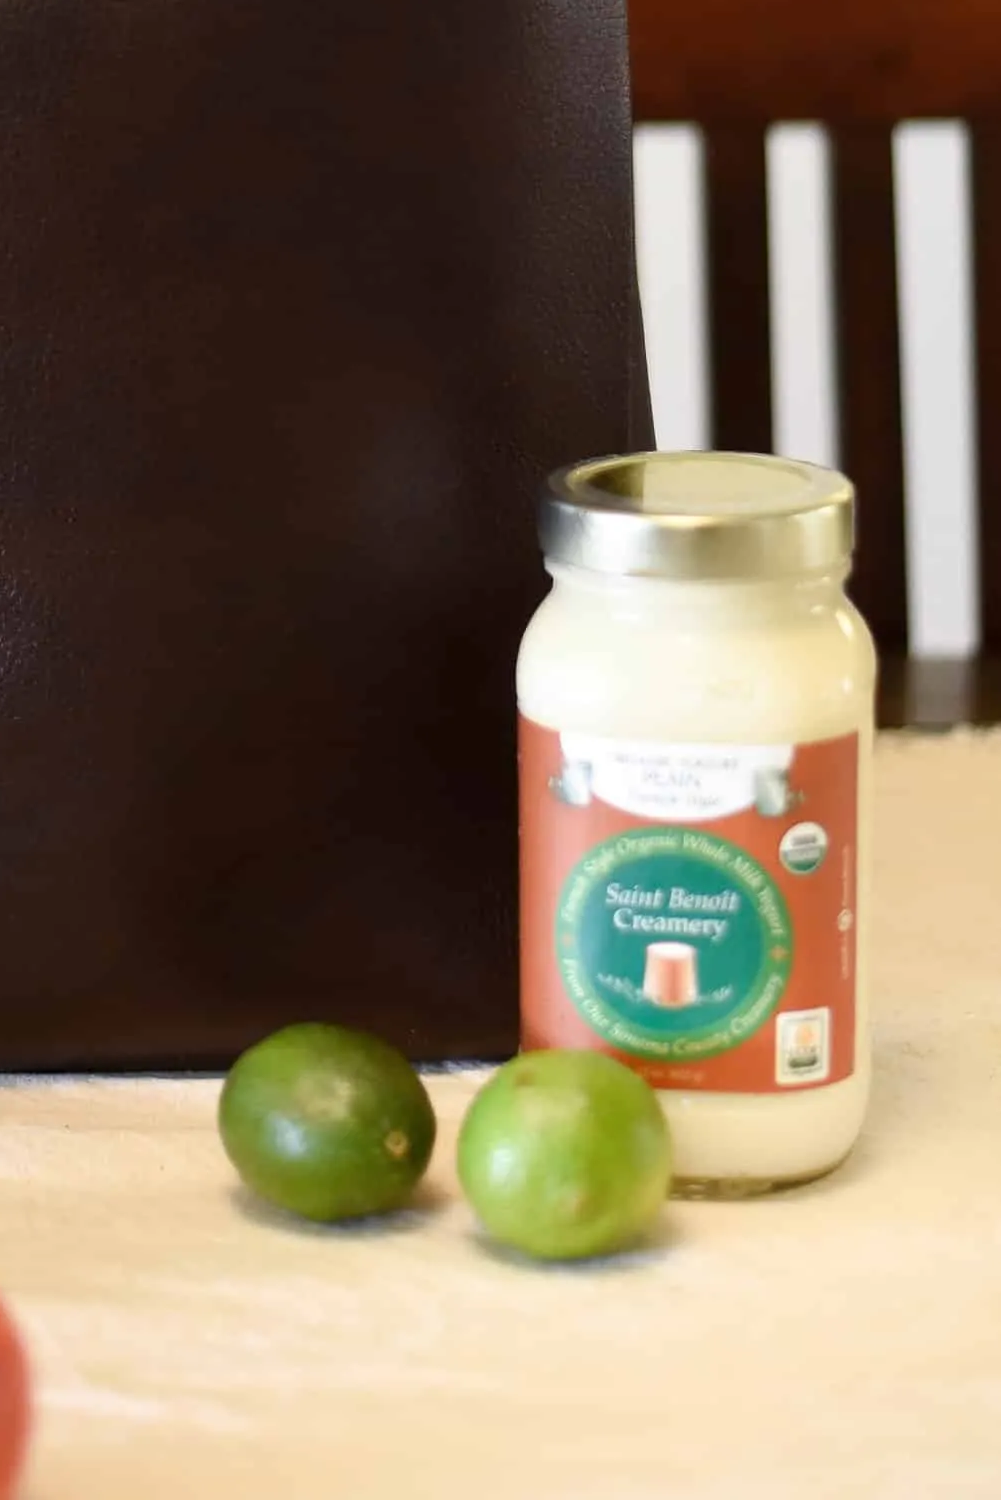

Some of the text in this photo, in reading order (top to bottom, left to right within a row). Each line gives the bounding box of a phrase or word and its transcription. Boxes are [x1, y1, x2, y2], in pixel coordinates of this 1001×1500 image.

[683, 831, 730, 862] Whole
[728, 855, 767, 891] Milk
[605, 881, 666, 908] Saint
[612, 907, 730, 943] Creamery
